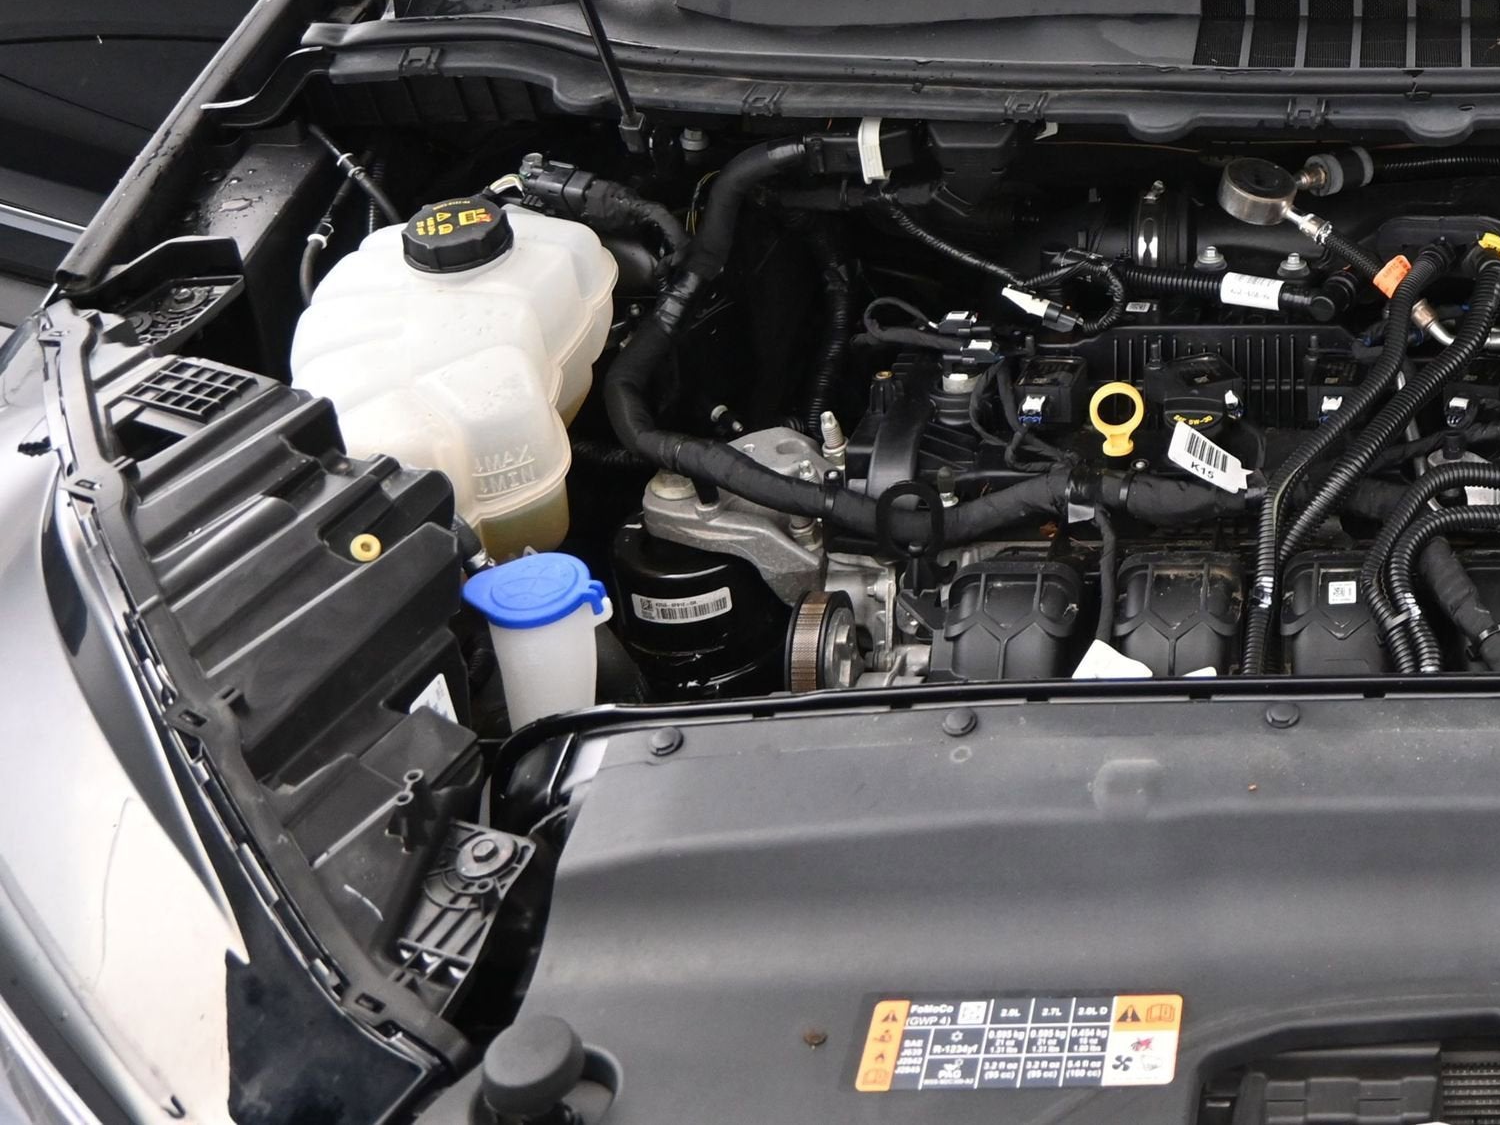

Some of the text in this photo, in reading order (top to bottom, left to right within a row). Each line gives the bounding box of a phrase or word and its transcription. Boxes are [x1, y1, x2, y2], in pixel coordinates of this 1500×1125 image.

[484, 443, 534, 472] MAX
[1190, 461, 1214, 479] K15
[489, 464, 536, 493] MIN
[910, 1004, 954, 1014] FoMoCo
[906, 1016, 952, 1027] (GWP 4)
[932, 1043, 979, 1055] R-1234yf
